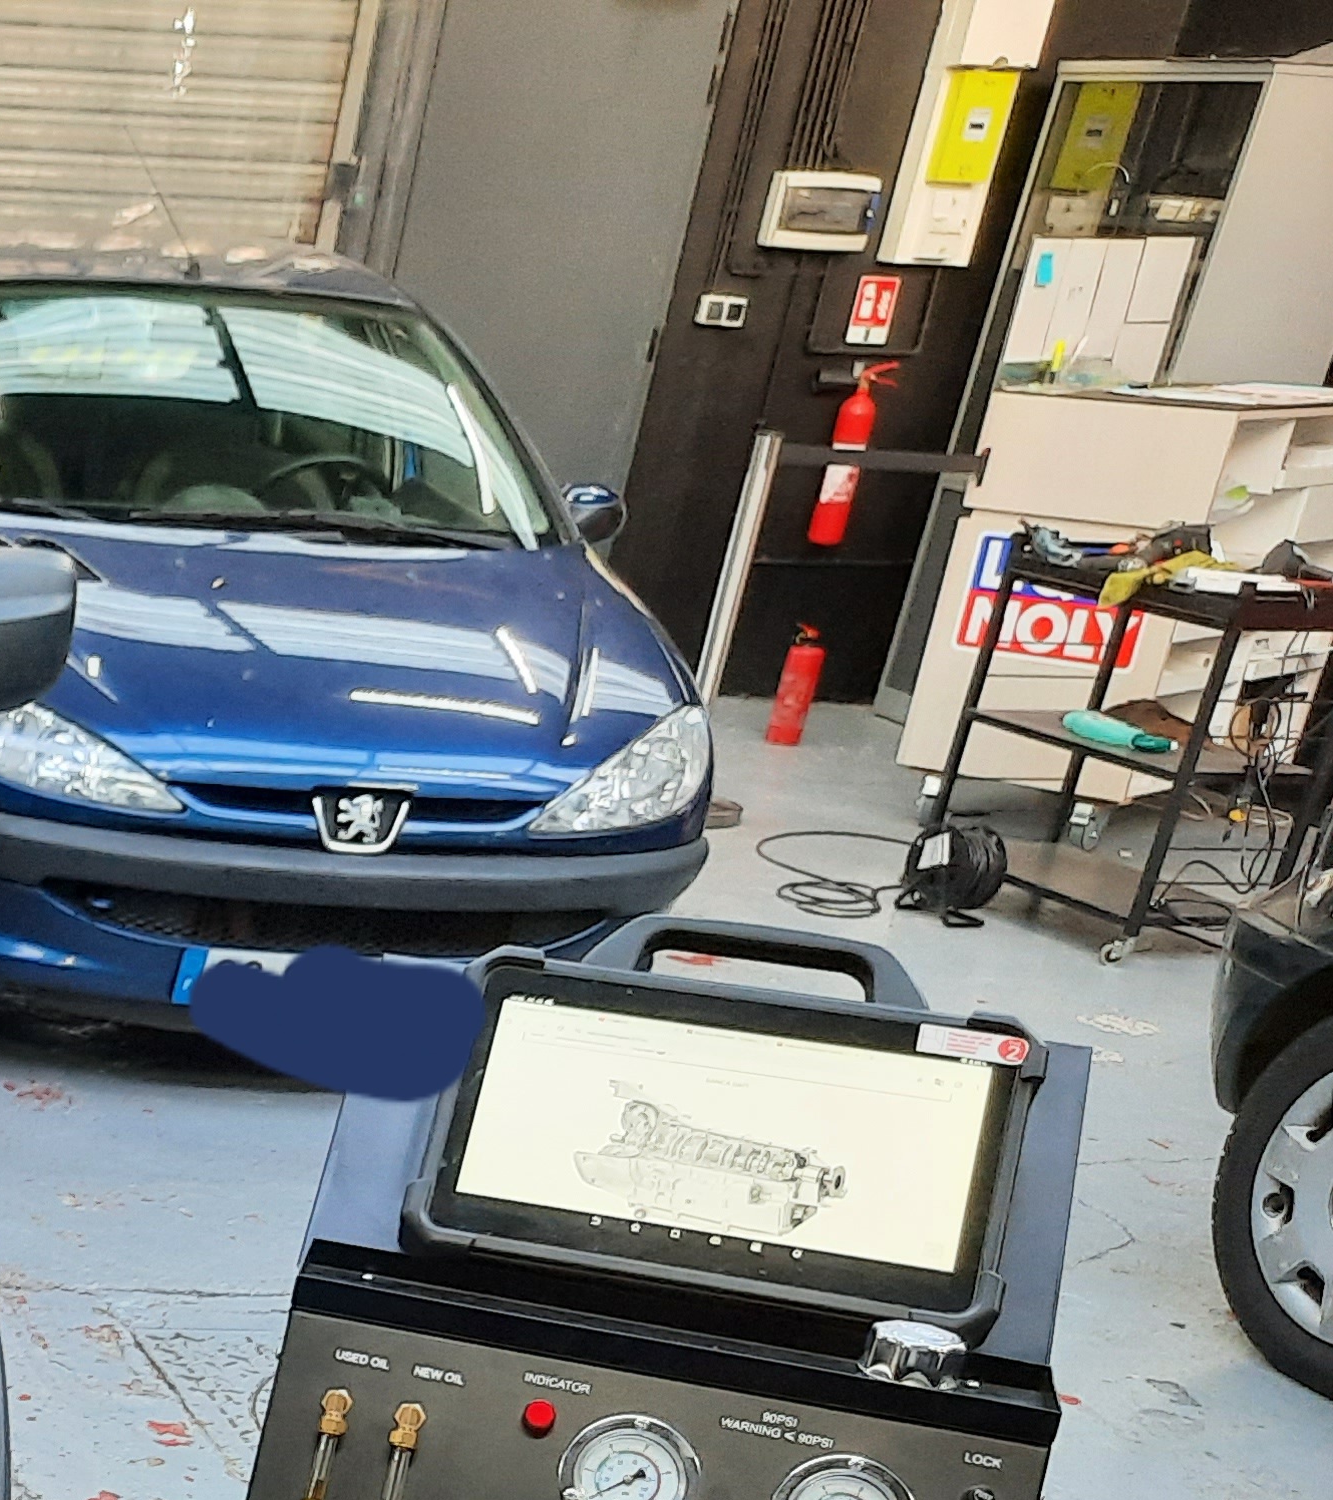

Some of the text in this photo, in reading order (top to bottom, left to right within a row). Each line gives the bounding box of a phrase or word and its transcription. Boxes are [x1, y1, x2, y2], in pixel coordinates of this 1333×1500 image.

[335, 1349, 389, 1371] USED OIL
[413, 1365, 464, 1386] NEW OIL
[524, 1372, 592, 1395] INDICATOR
[762, 1411, 798, 1428] 90PSI
[721, 1417, 781, 1439] WARNING
[798, 1433, 834, 1448] 90PSI
[964, 1452, 1003, 1469] LOCK
